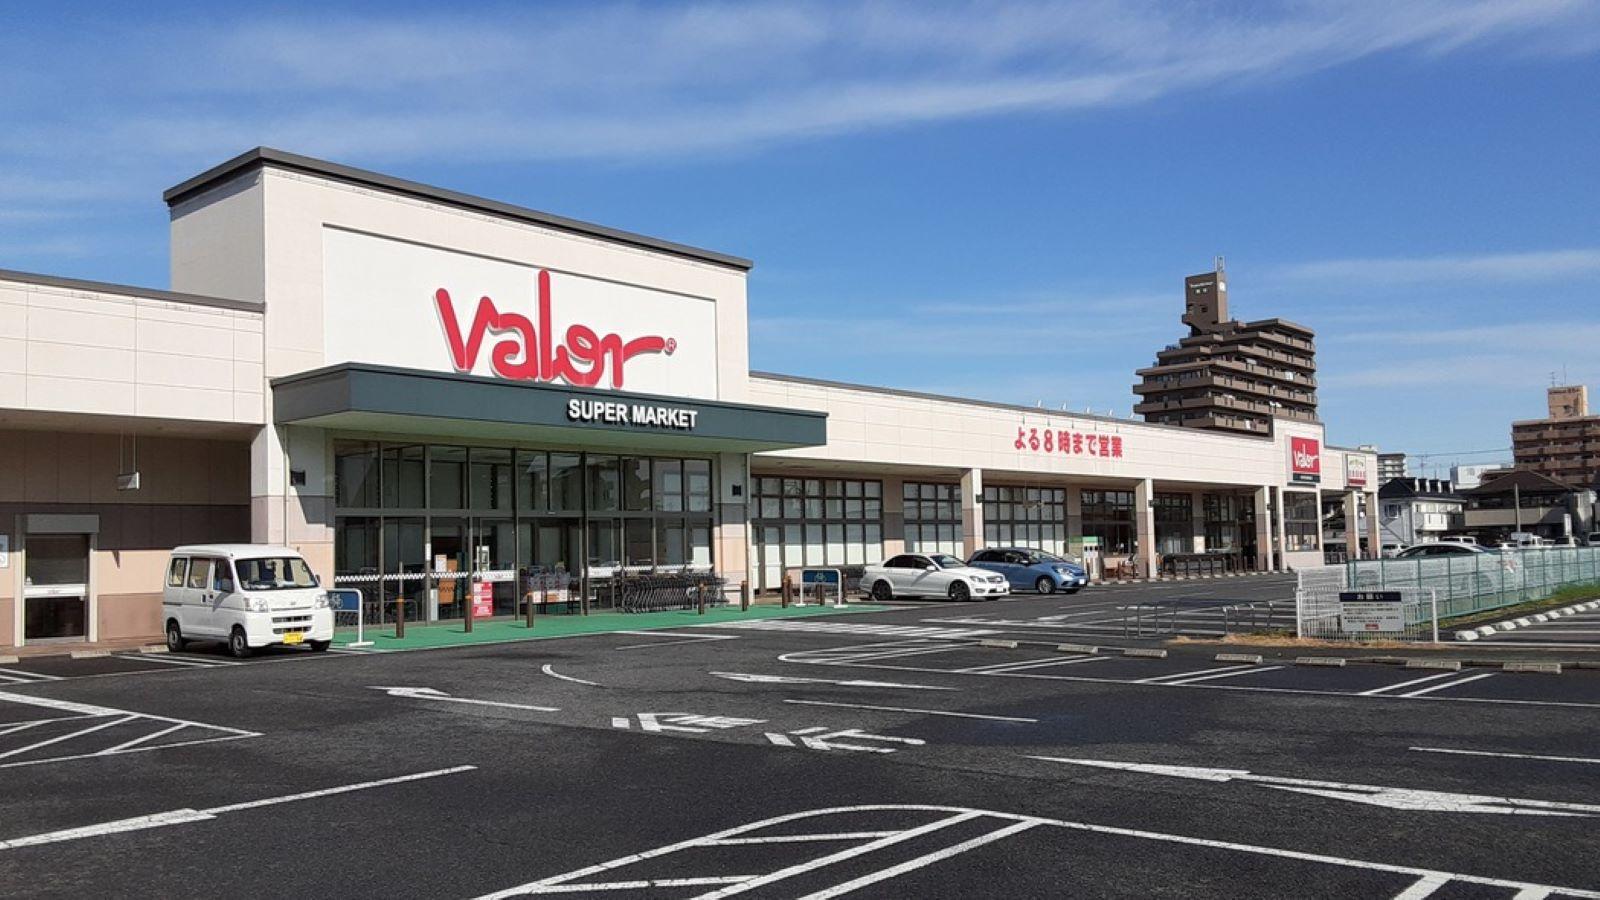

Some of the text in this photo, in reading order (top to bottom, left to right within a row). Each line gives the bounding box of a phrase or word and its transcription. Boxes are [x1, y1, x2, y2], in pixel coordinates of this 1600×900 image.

[569, 398, 698, 428] SUPER MARKET
[1014, 426, 1122, 458] よる8時まで営業
